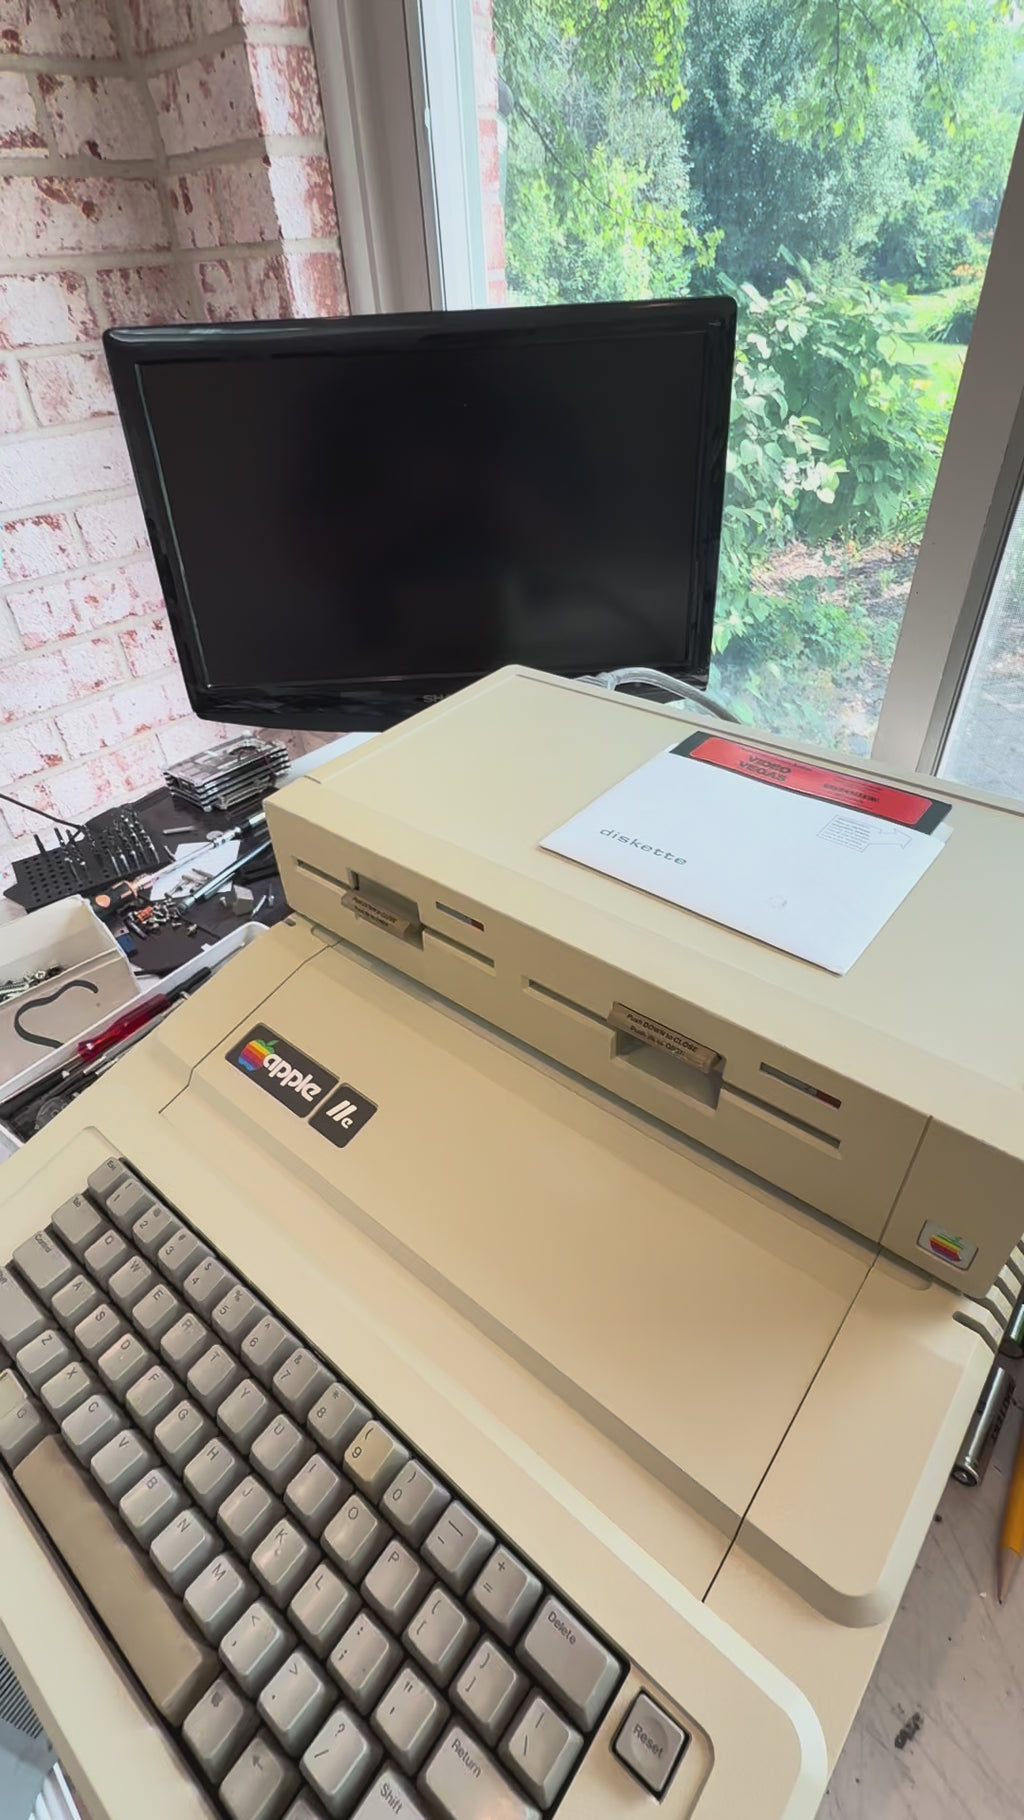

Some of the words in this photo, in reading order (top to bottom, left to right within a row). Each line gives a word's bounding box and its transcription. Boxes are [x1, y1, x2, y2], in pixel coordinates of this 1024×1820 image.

[749, 756, 791, 774] VIDEO
[739, 761, 787, 782] VEGAS
[600, 828, 687, 865] diskette
[627, 1013, 643, 1025] Push
[643, 1021, 666, 1037] DOWN
[666, 1033, 674, 1041] to
[673, 1037, 698, 1053] CLOSE
[263, 1053, 322, 1102] apple
[140, 1220, 148, 1229] 2
[166, 1246, 174, 1255] 3
[130, 1260, 140, 1272] W
[73, 1281, 83, 1291] A
[192, 1276, 200, 1285] 4
[153, 1290, 164, 1300] E
[220, 1305, 230, 1315] 5
[96, 1312, 106, 1322] S
[182, 1319, 192, 1330] R
[42, 1334, 52, 1346] Z
[120, 1340, 131, 1350] D
[250, 1337, 258, 1347] 6
[209, 1353, 220, 1363] T
[66, 1367, 78, 1380] X
[148, 1372, 160, 1383] F
[280, 1370, 291, 1380] 7
[240, 1388, 250, 1398] Y
[88, 1402, 99, 1412] C
[316, 1406, 326, 1418] 8
[177, 1408, 188, 1421] G
[274, 1422, 284, 1435] U
[364, 1428, 374, 1440] (
[118, 1436, 130, 1448] V
[206, 1446, 219, 1460] H
[352, 1446, 362, 1458] 9
[146, 1476, 158, 1490] B
[408, 1472, 416, 1484] )
[242, 1488, 253, 1497] J
[348, 1506, 358, 1520] O
[176, 1518, 190, 1532] N
[276, 1528, 288, 1544] K
[388, 1551, 400, 1563] P
[212, 1563, 226, 1582] M
[498, 1562, 506, 1572] +
[315, 1575, 324, 1590] L
[482, 1582, 493, 1593] =
[251, 1615, 260, 1626] <
[548, 1611, 576, 1645] Delete
[290, 1662, 298, 1675] >
[334, 1724, 346, 1737] ?
[633, 1723, 664, 1758] Reset
[314, 1750, 329, 1758] /
[452, 1738, 482, 1778] Return
[380, 1783, 402, 1814] Shift
